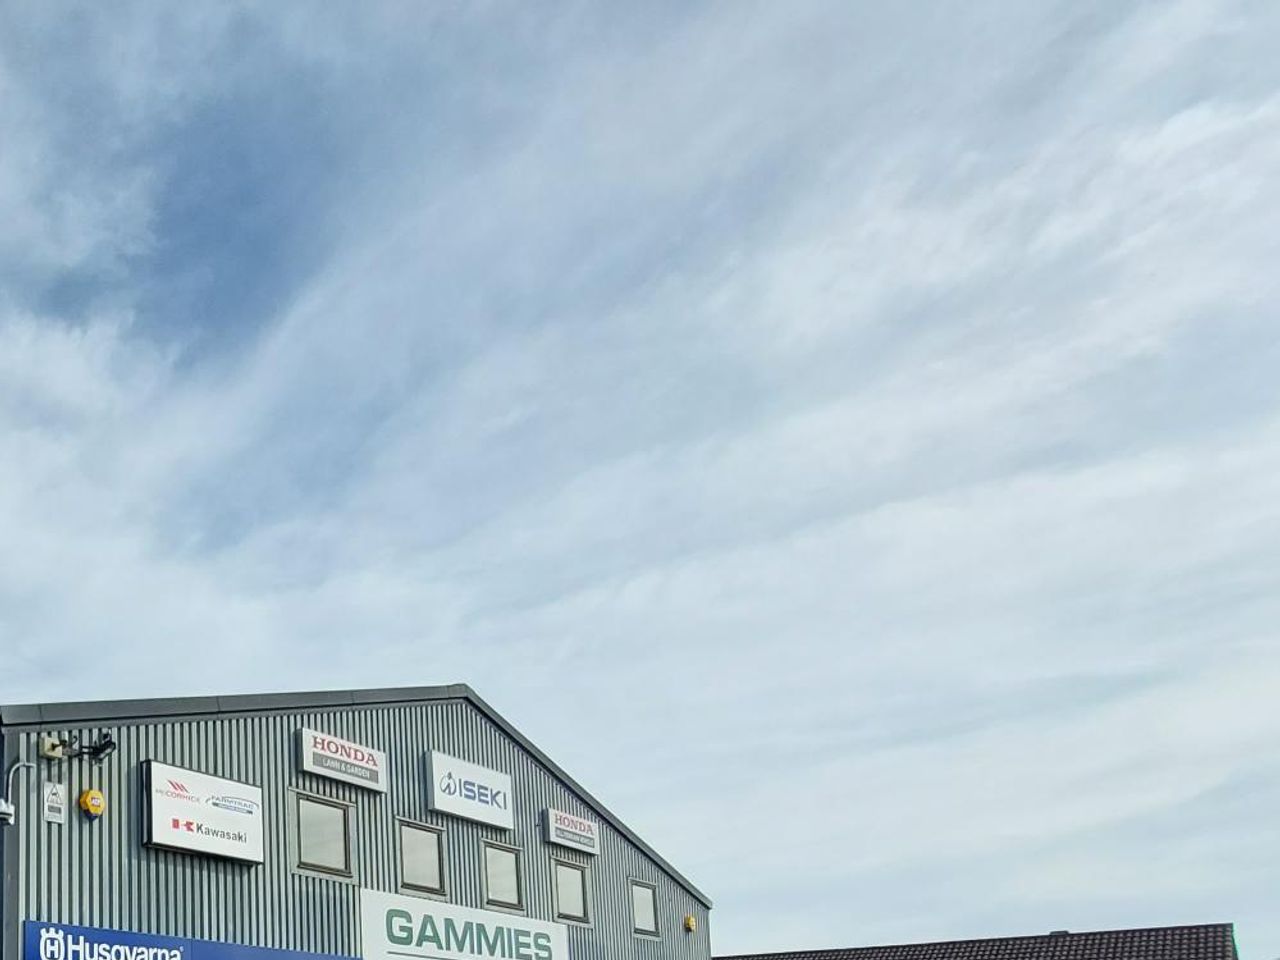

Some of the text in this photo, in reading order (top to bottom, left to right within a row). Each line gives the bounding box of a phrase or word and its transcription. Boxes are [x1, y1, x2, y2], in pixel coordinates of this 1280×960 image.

[312, 735, 378, 767] HONDA
[458, 777, 508, 810] ISEKI
[196, 823, 247, 844] Kawasaki
[554, 812, 594, 836] HONDA
